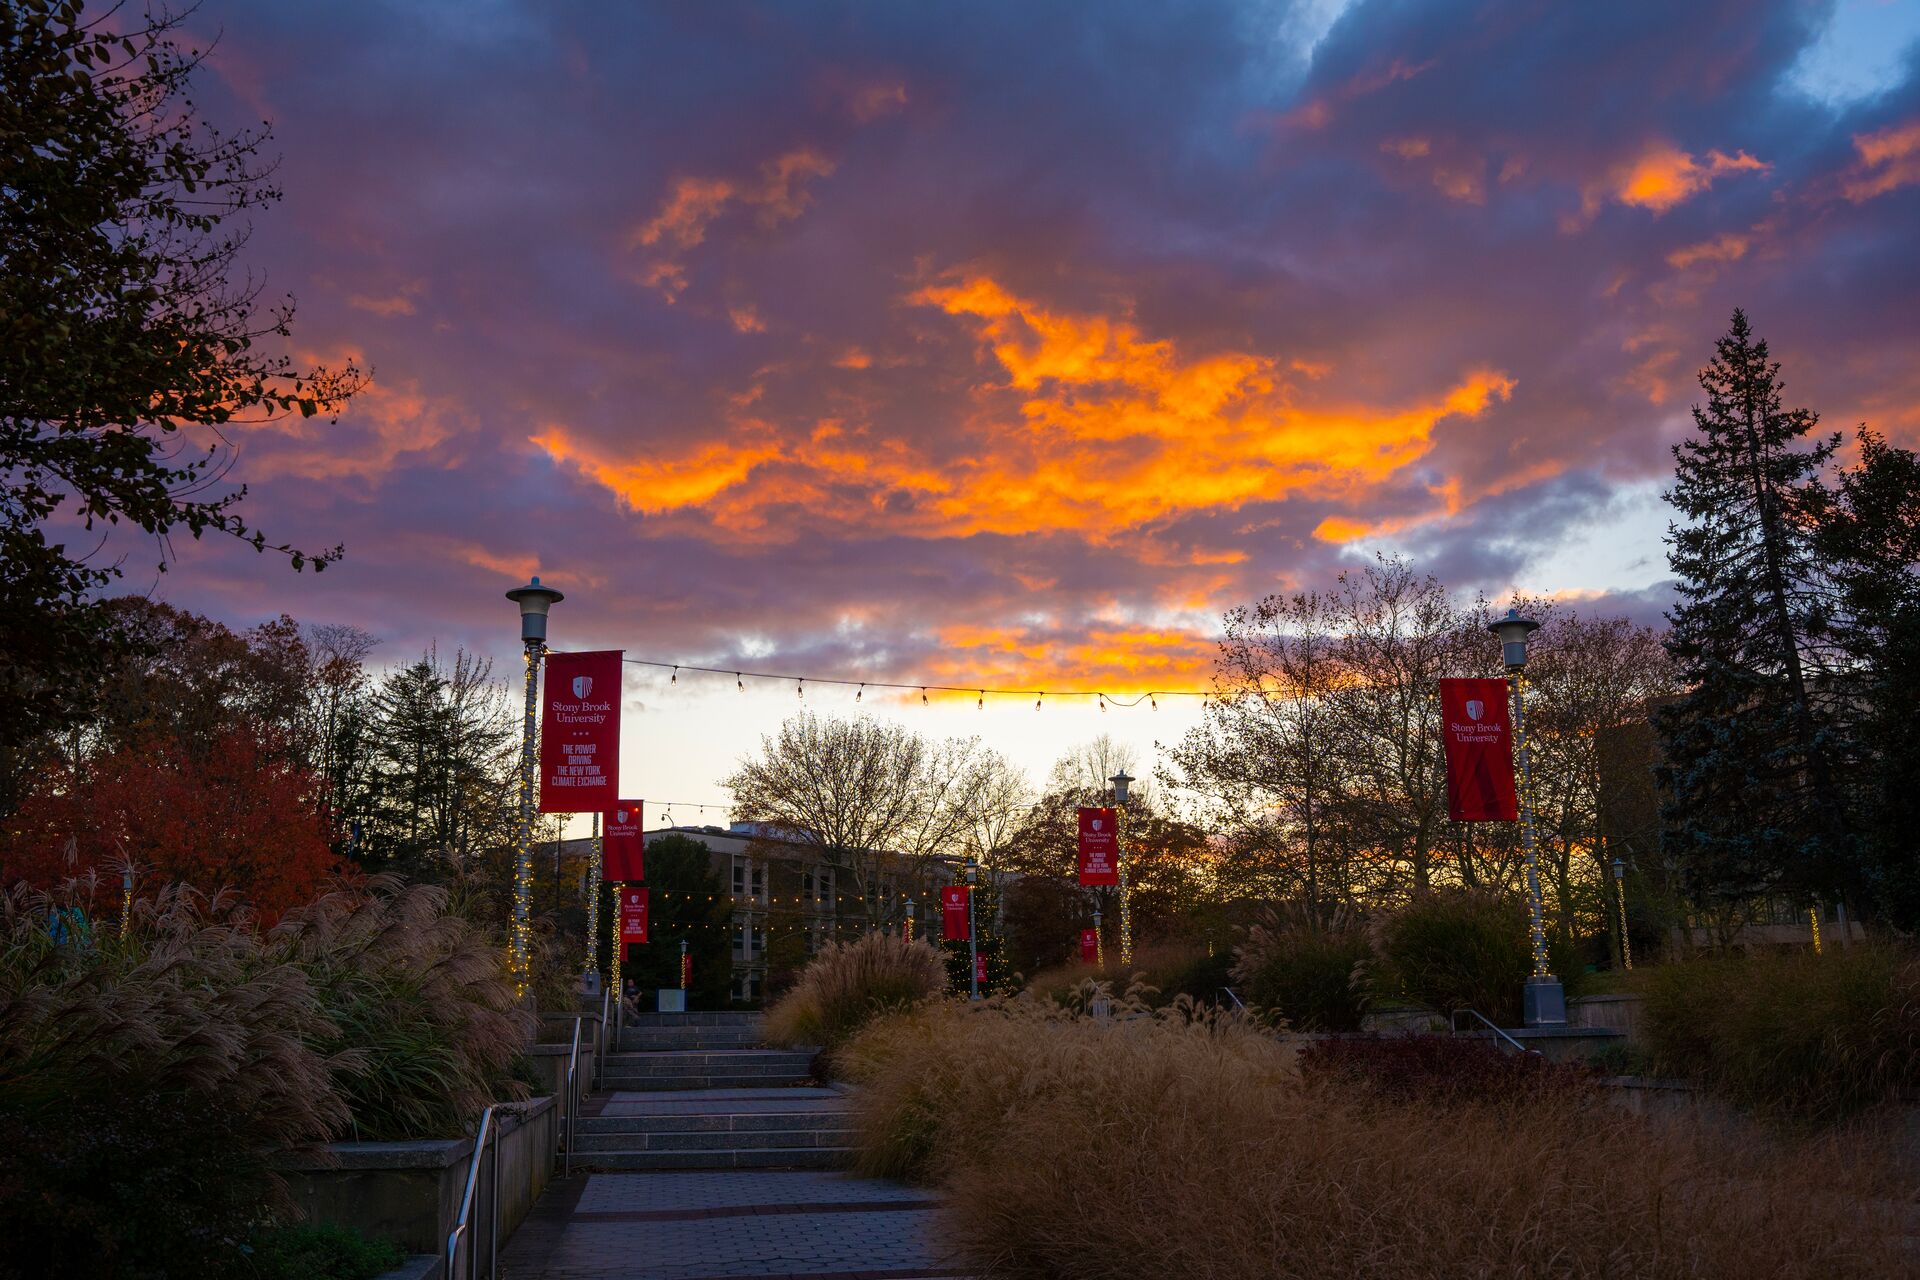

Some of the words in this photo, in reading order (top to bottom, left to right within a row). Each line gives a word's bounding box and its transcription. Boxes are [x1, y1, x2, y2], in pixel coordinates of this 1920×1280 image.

[552, 701, 580, 714] Stony
[582, 701, 611, 711] Brook
[556, 713, 606, 724] University
[1451, 722, 1476, 734] Stony
[1477, 723, 1502, 732] Brook
[1455, 733, 1498, 744] University
[562, 744, 573, 754] THE
[574, 744, 596, 754] POWER
[568, 755, 592, 765] DRIVING
[557, 766, 568, 776] THE
[569, 766, 584, 776] NEW
[585, 766, 601, 776] YORK
[552, 777, 576, 786] CLIMATE
[577, 776, 607, 786] EXCHANGE
